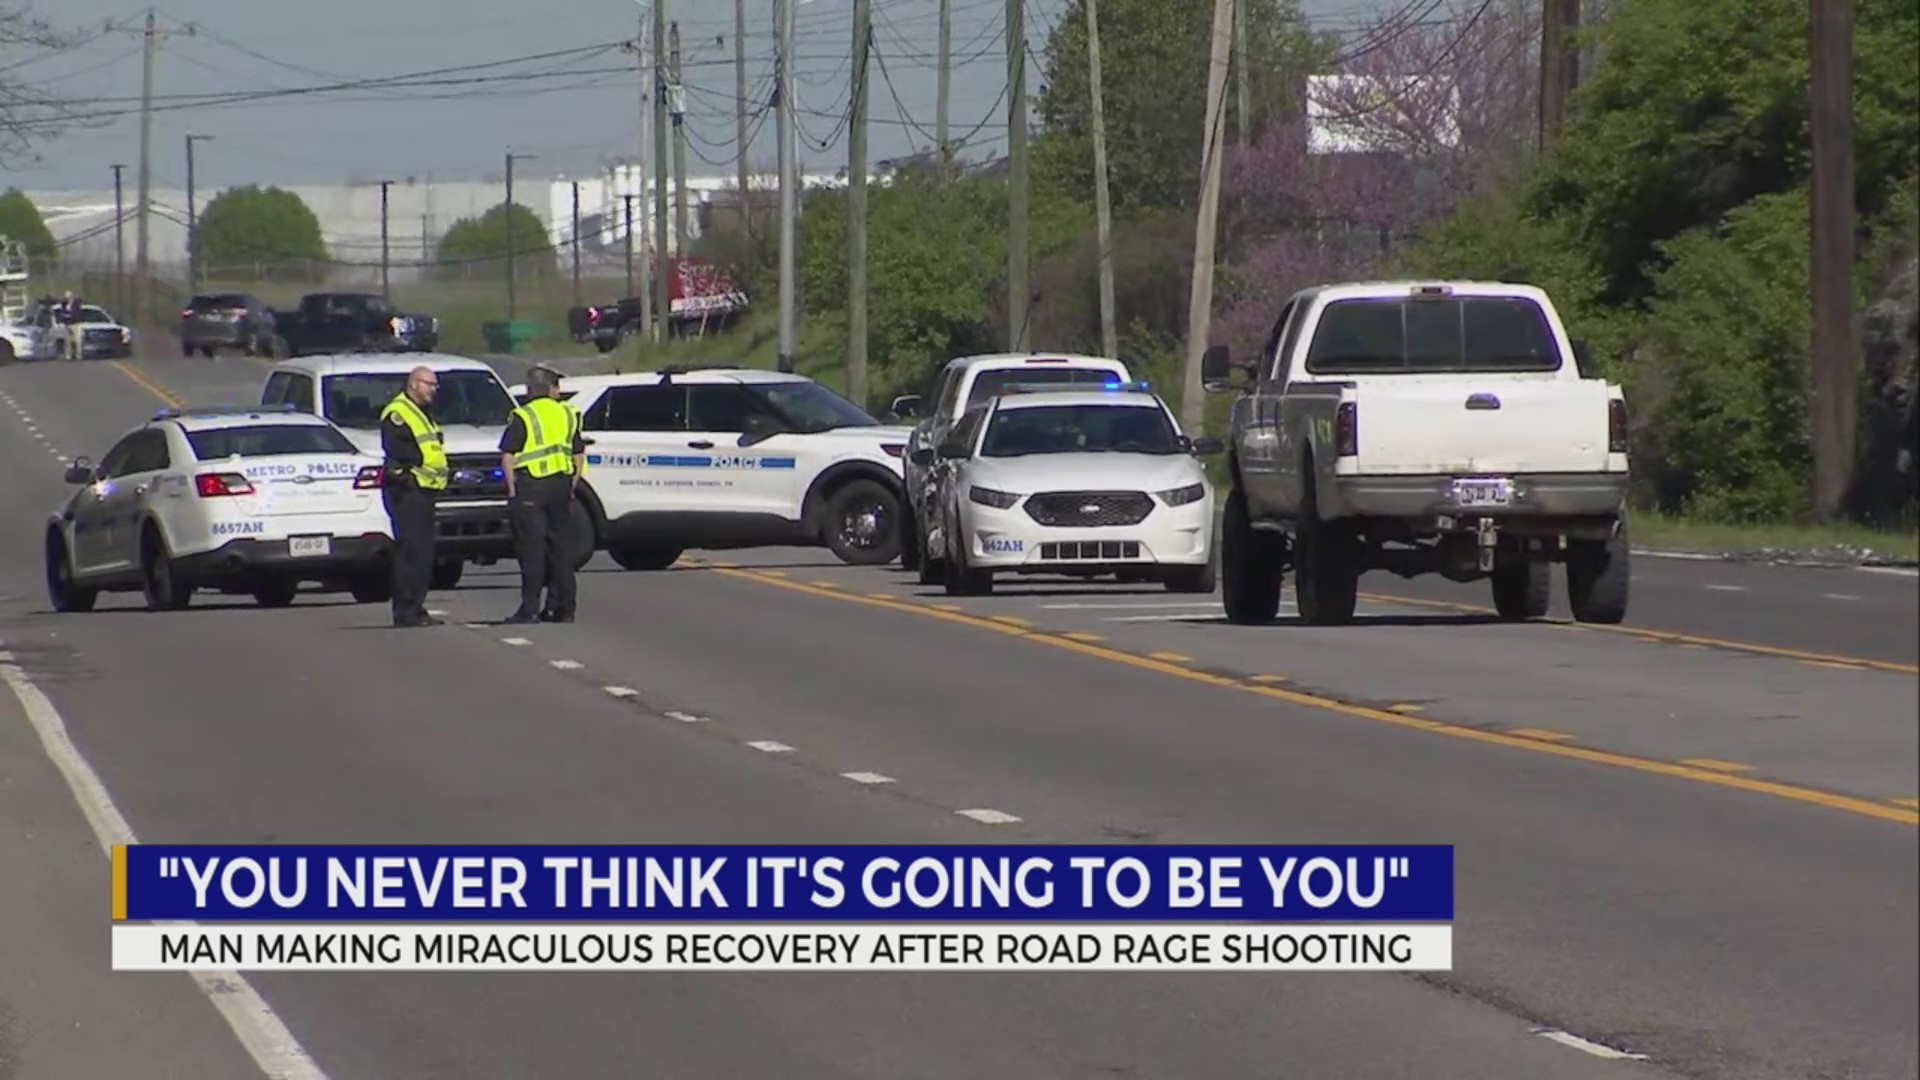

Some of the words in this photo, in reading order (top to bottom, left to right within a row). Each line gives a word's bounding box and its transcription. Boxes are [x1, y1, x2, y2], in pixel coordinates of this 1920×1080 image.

[246, 465, 296, 478] METRO
[308, 463, 357, 475] POLICE
[212, 522, 264, 535] 8657AH
